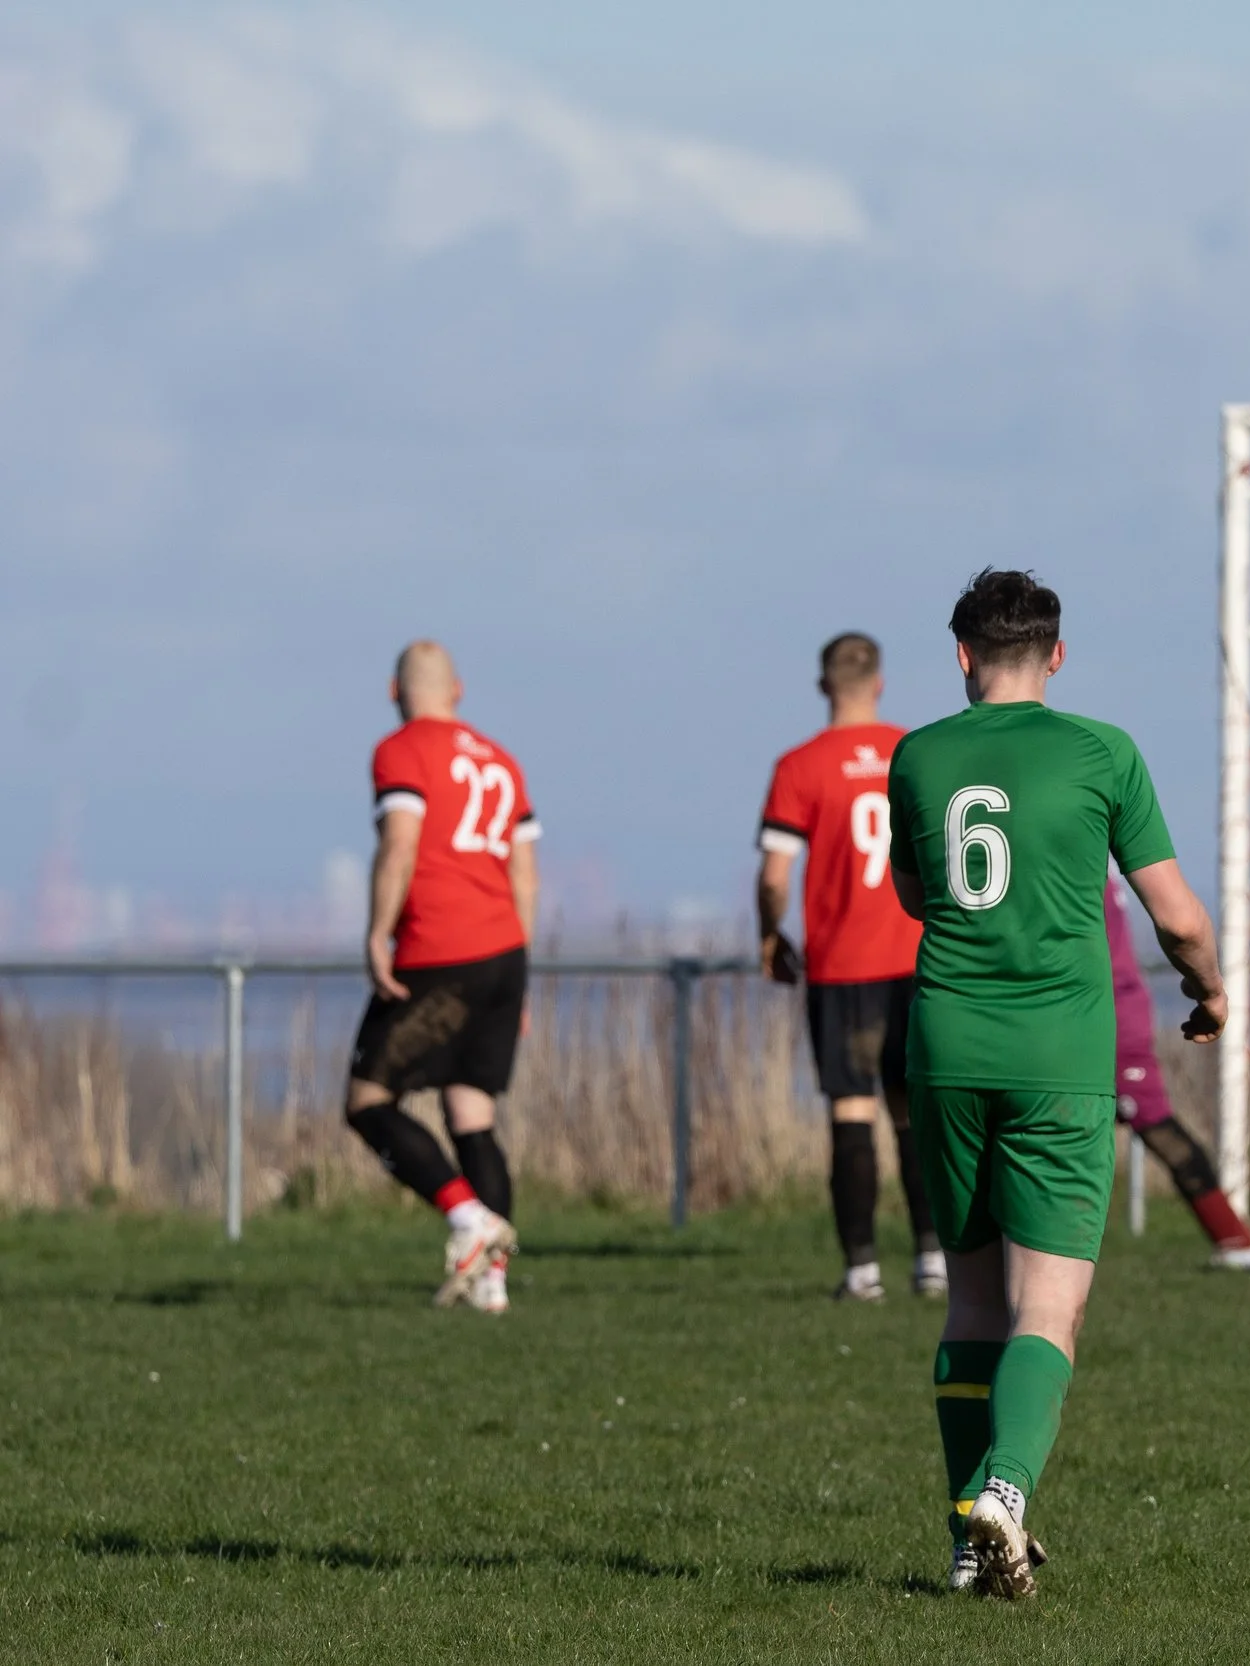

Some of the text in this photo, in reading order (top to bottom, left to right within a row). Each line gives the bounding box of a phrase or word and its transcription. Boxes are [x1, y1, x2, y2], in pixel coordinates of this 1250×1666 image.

[450, 754, 516, 860] 22
[851, 791, 892, 889] 9
[944, 785, 1011, 910] 6
